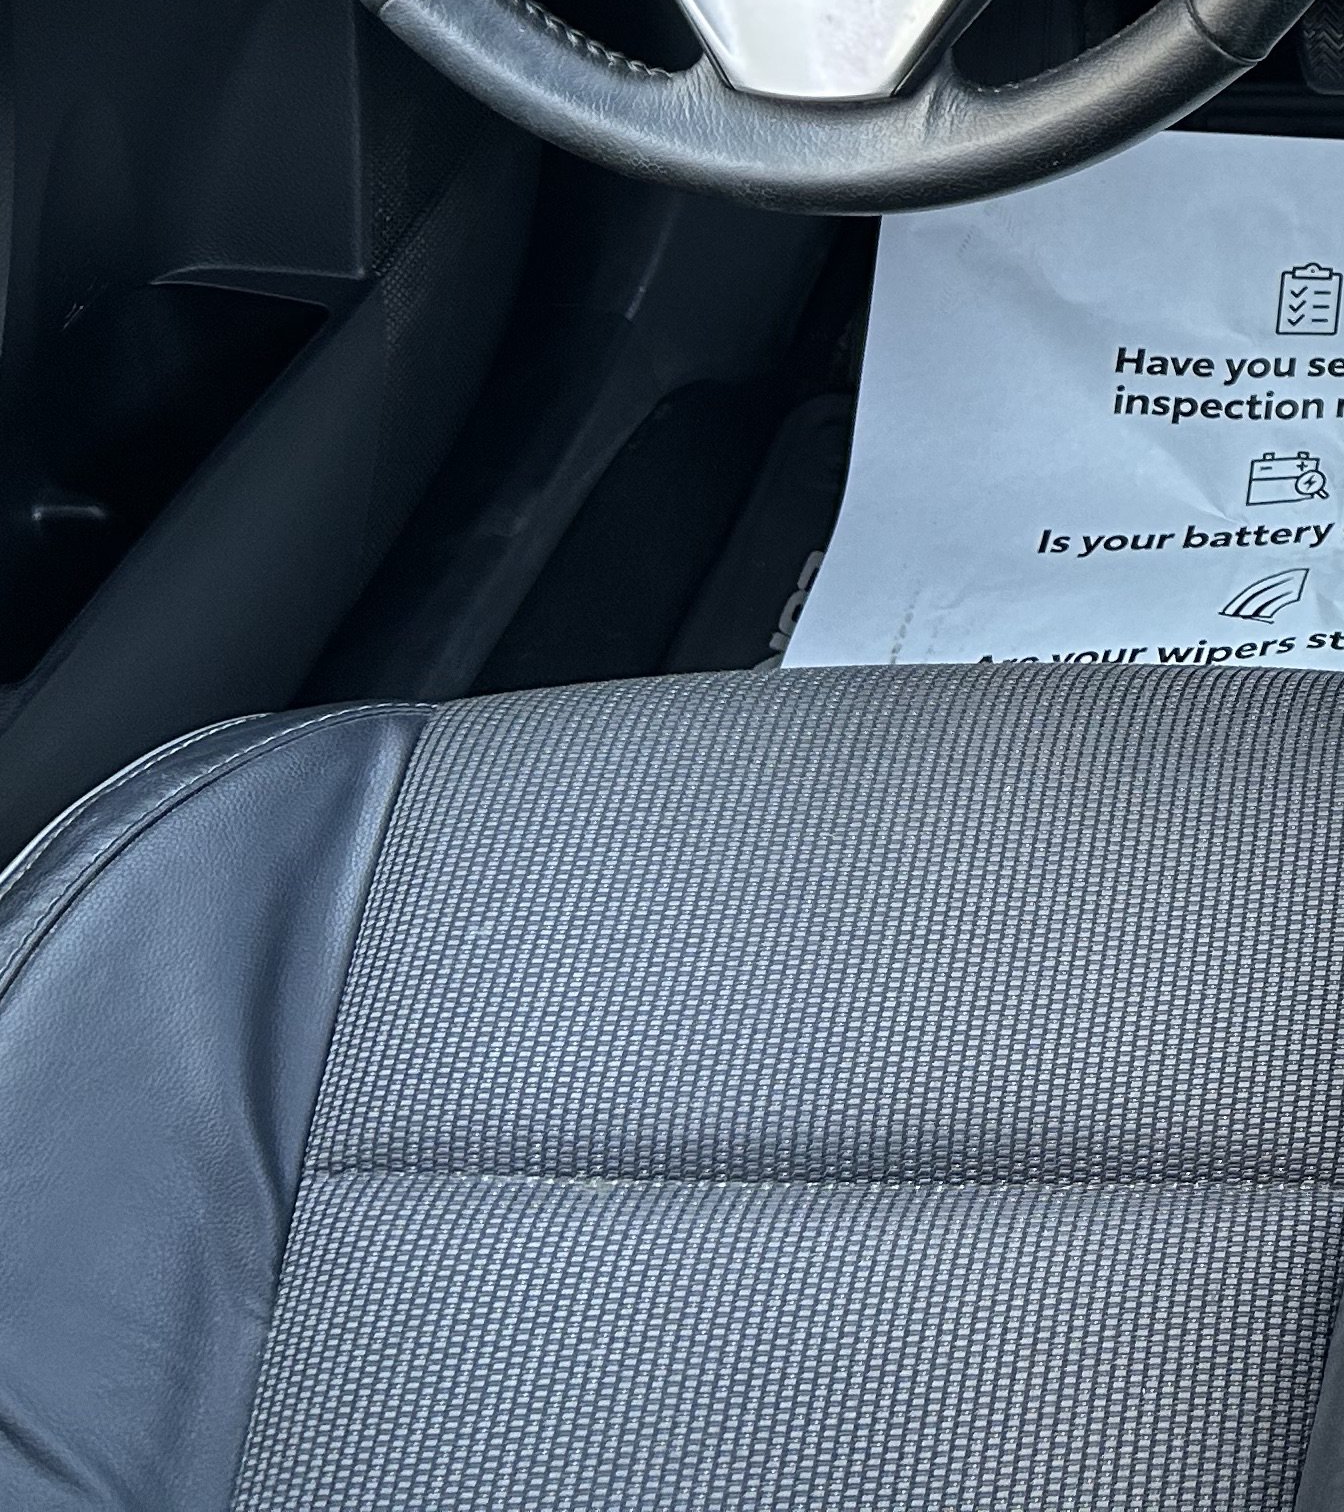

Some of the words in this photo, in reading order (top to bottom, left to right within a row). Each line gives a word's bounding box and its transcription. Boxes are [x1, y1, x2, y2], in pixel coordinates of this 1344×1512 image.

[1115, 346, 1214, 379] Have
[1224, 354, 1296, 386] you
[1113, 384, 1325, 425] inspection
[1037, 529, 1071, 555] Is
[1078, 531, 1174, 558] your
[1183, 521, 1335, 550] battery
[1157, 637, 1296, 665] wipers
